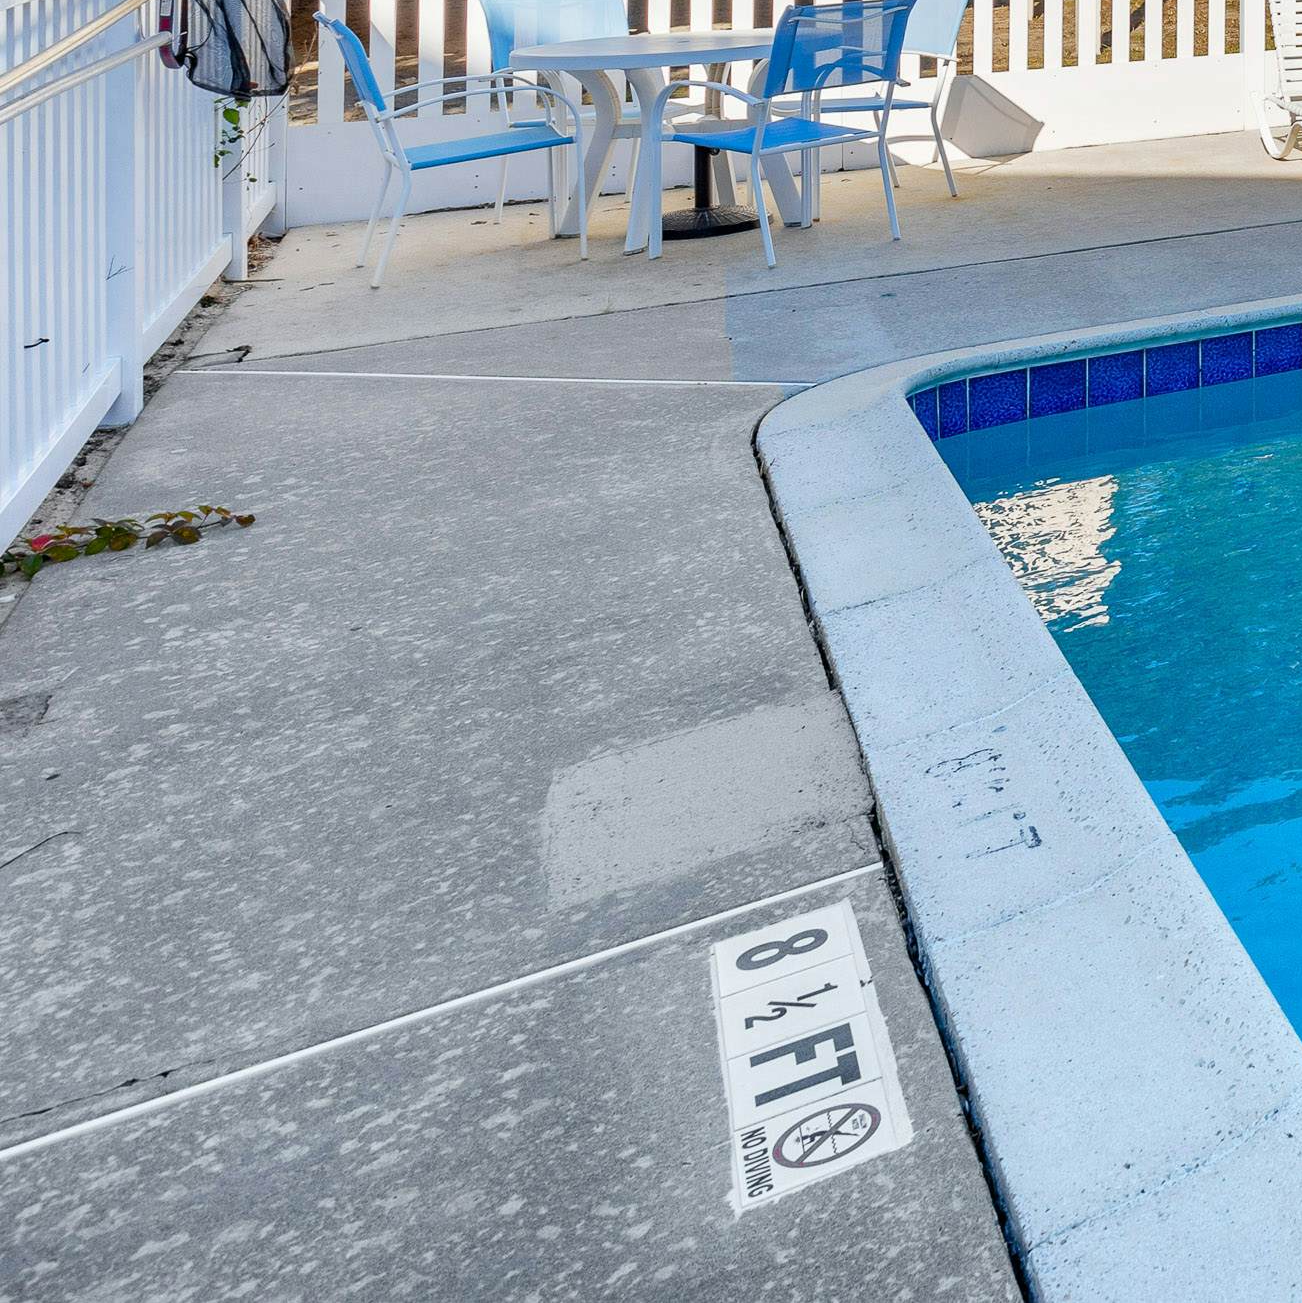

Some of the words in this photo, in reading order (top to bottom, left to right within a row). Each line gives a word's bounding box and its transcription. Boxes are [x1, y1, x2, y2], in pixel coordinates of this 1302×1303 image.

[736, 928, 829, 971] 8
[749, 1022, 862, 1107] FT
[740, 1126, 767, 1149] NO
[743, 1147, 774, 1198] DIVING
